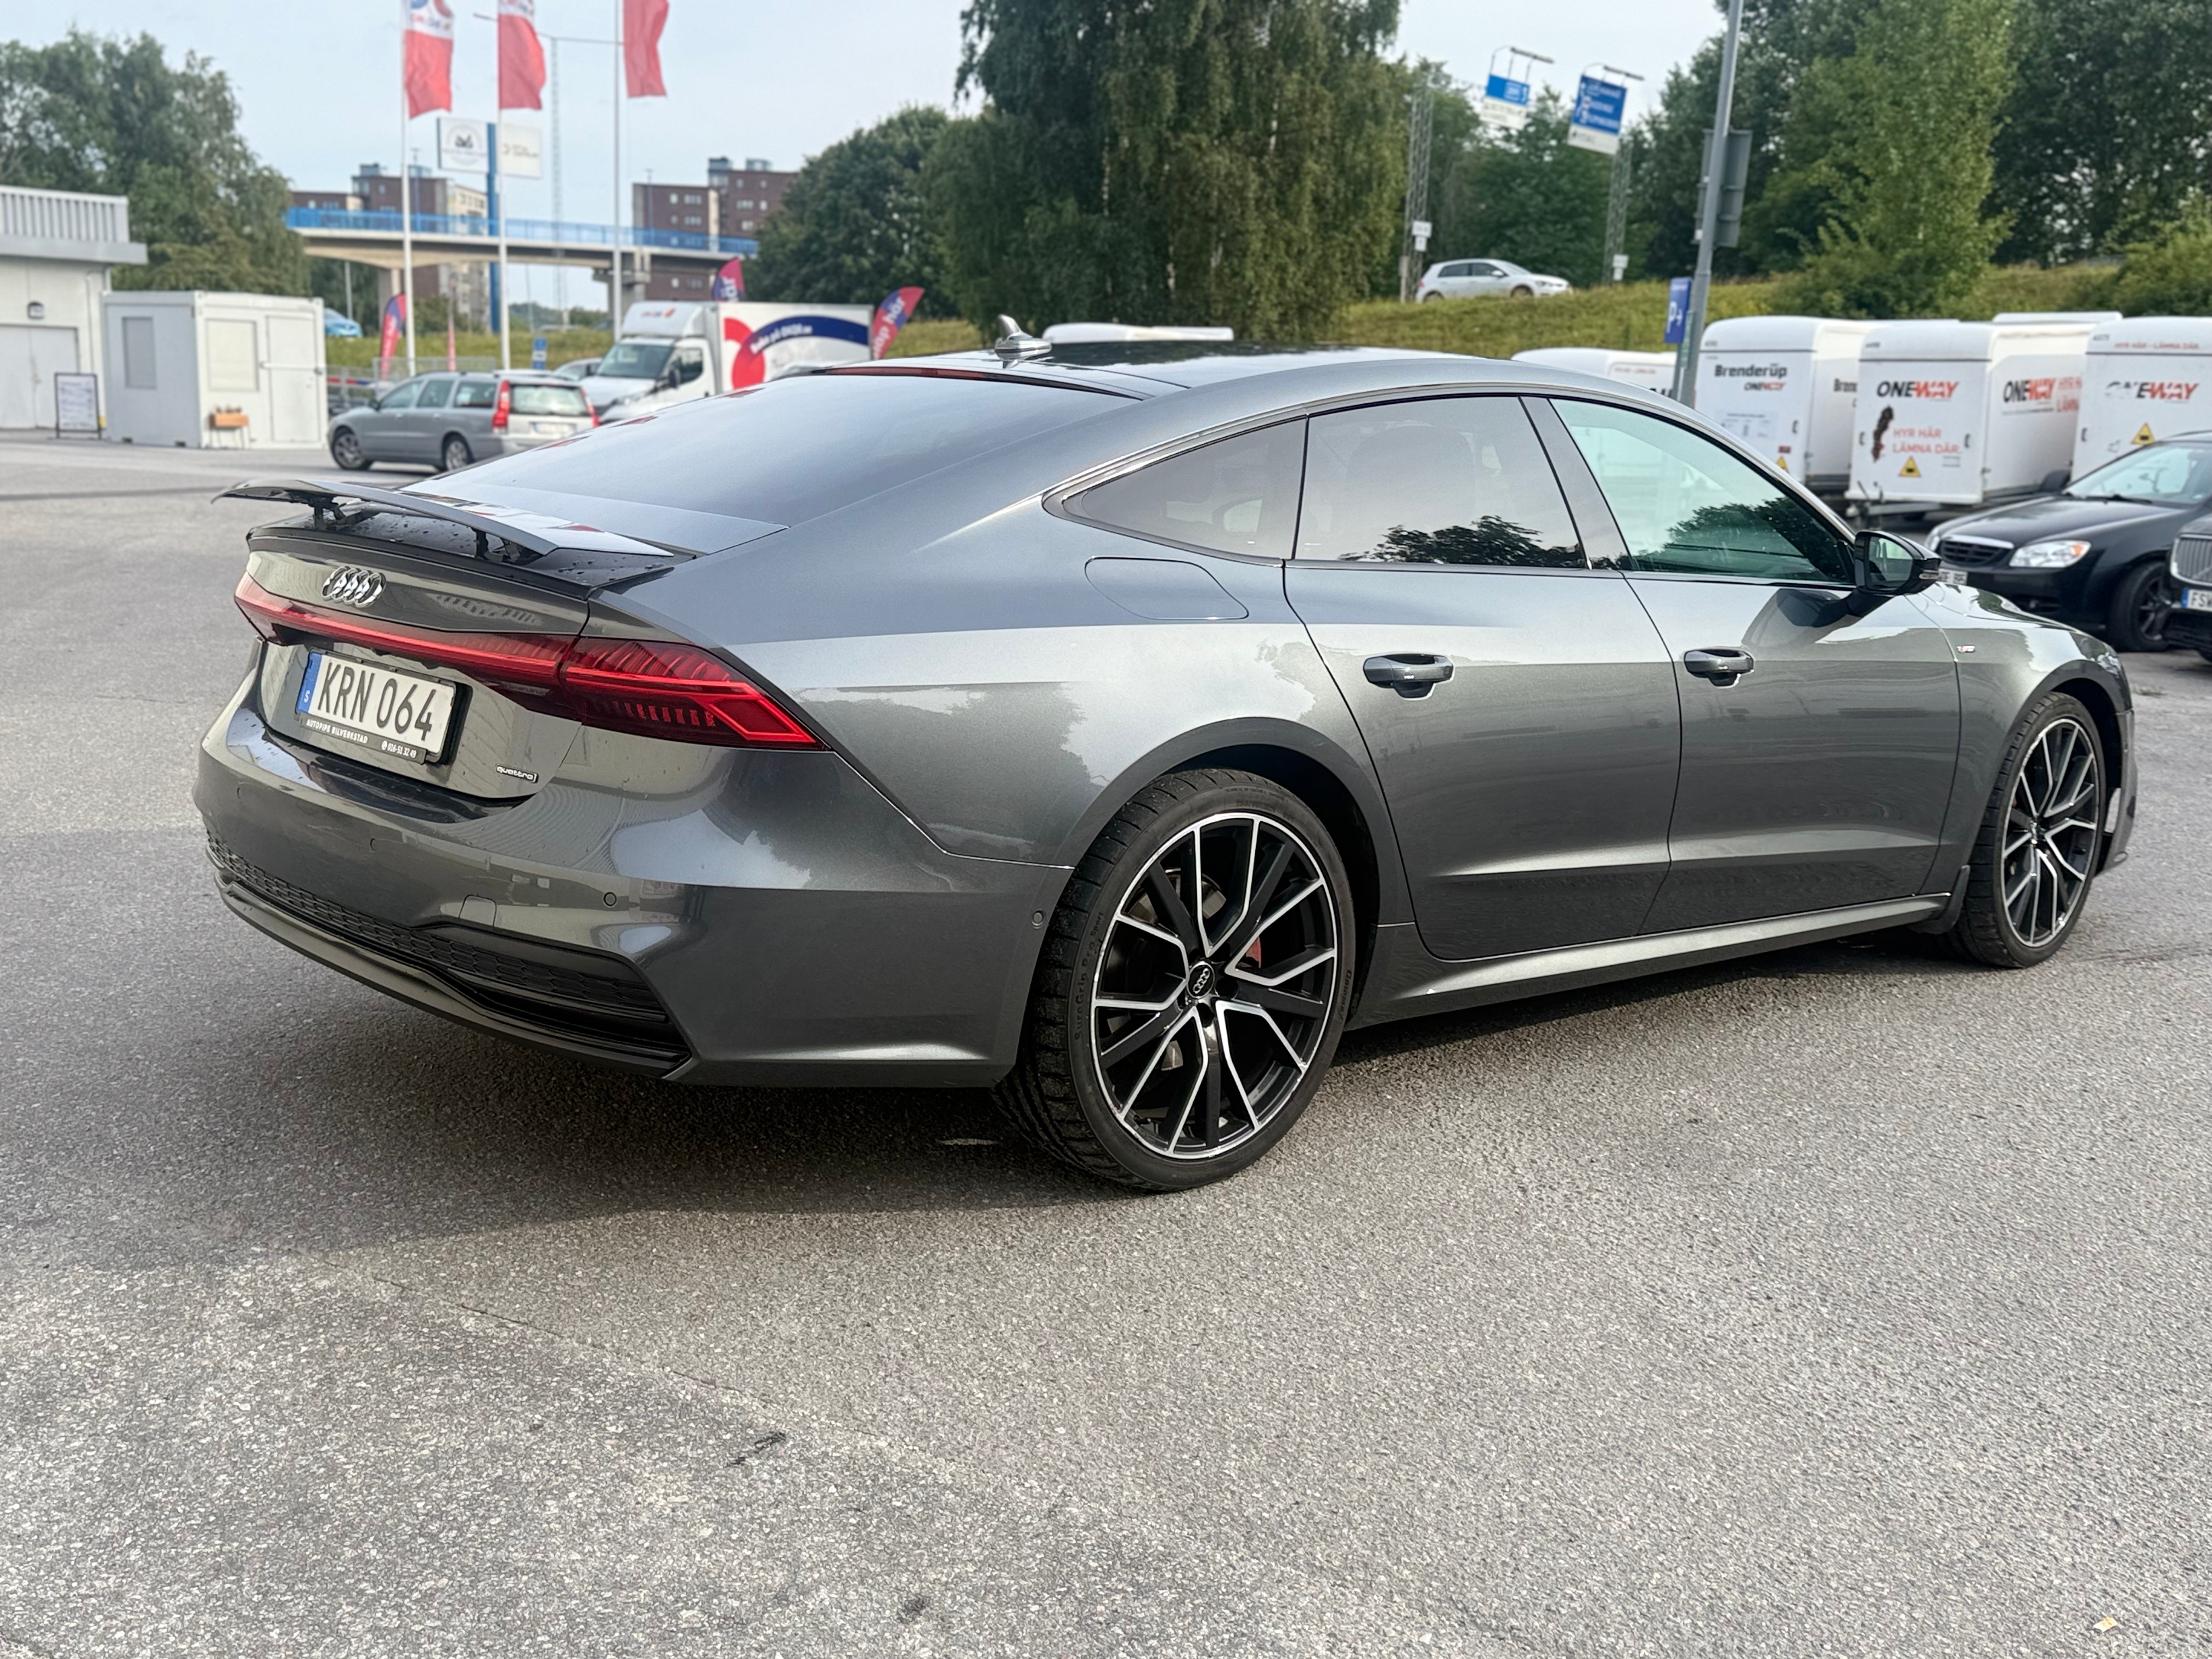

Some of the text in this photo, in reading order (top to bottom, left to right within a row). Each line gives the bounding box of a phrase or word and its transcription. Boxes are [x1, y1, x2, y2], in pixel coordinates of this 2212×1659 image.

[1876, 381, 1960, 398] ONEWAY
[1894, 426, 1941, 437] HYR HÄR
[1892, 441, 1931, 454] LÄMNA
[303, 690, 311, 703] S
[318, 662, 437, 741] KRN 064
[306, 719, 369, 744] AUTOPIPE BILVERKSTAD
[496, 766, 537, 783] quattro
